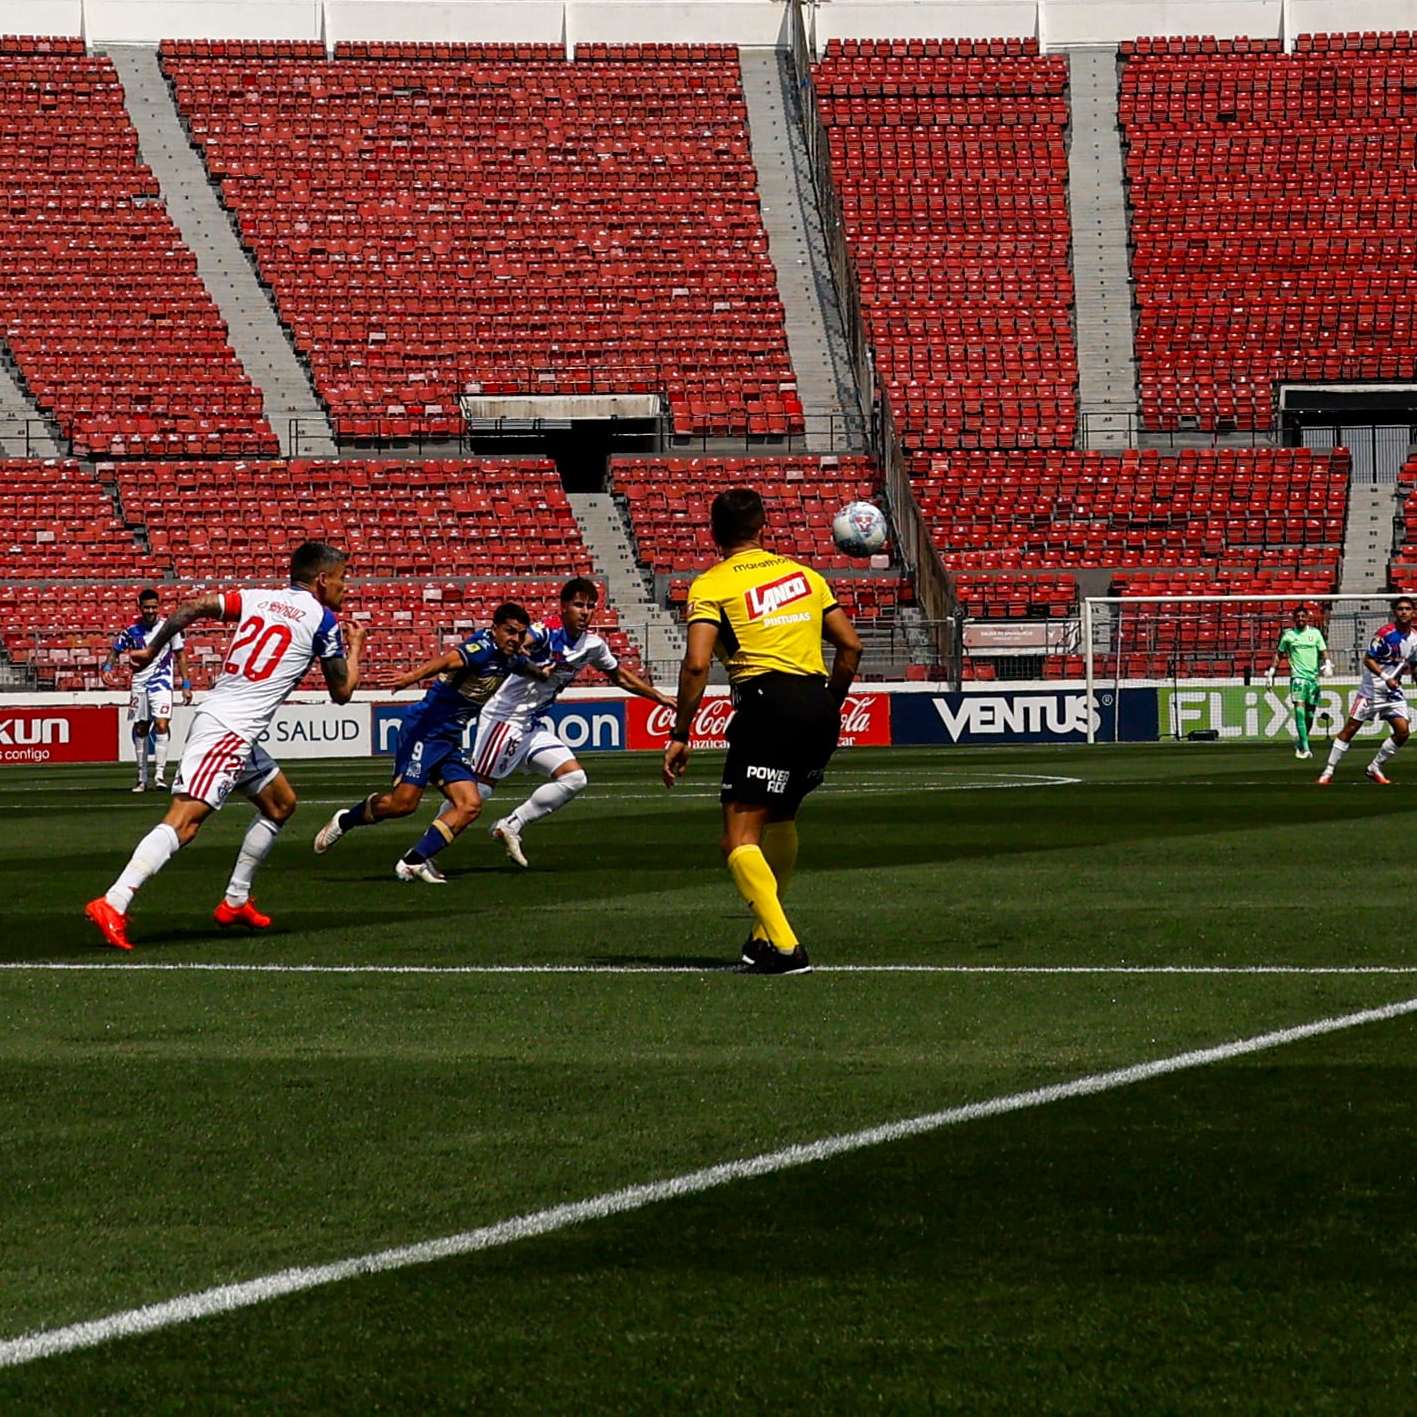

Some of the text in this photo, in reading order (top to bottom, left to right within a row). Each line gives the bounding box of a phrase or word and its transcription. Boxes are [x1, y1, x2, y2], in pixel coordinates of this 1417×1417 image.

[749, 576, 807, 616] LANCO
[763, 612, 811, 628] PINTURAS
[225, 616, 292, 682] 20
[932, 695, 1101, 742] VENTUS
[277, 719, 359, 742] SALUD
[5, 747, 50, 763] contigo
[411, 741, 424, 761] 9
[746, 766, 790, 782] POWER
